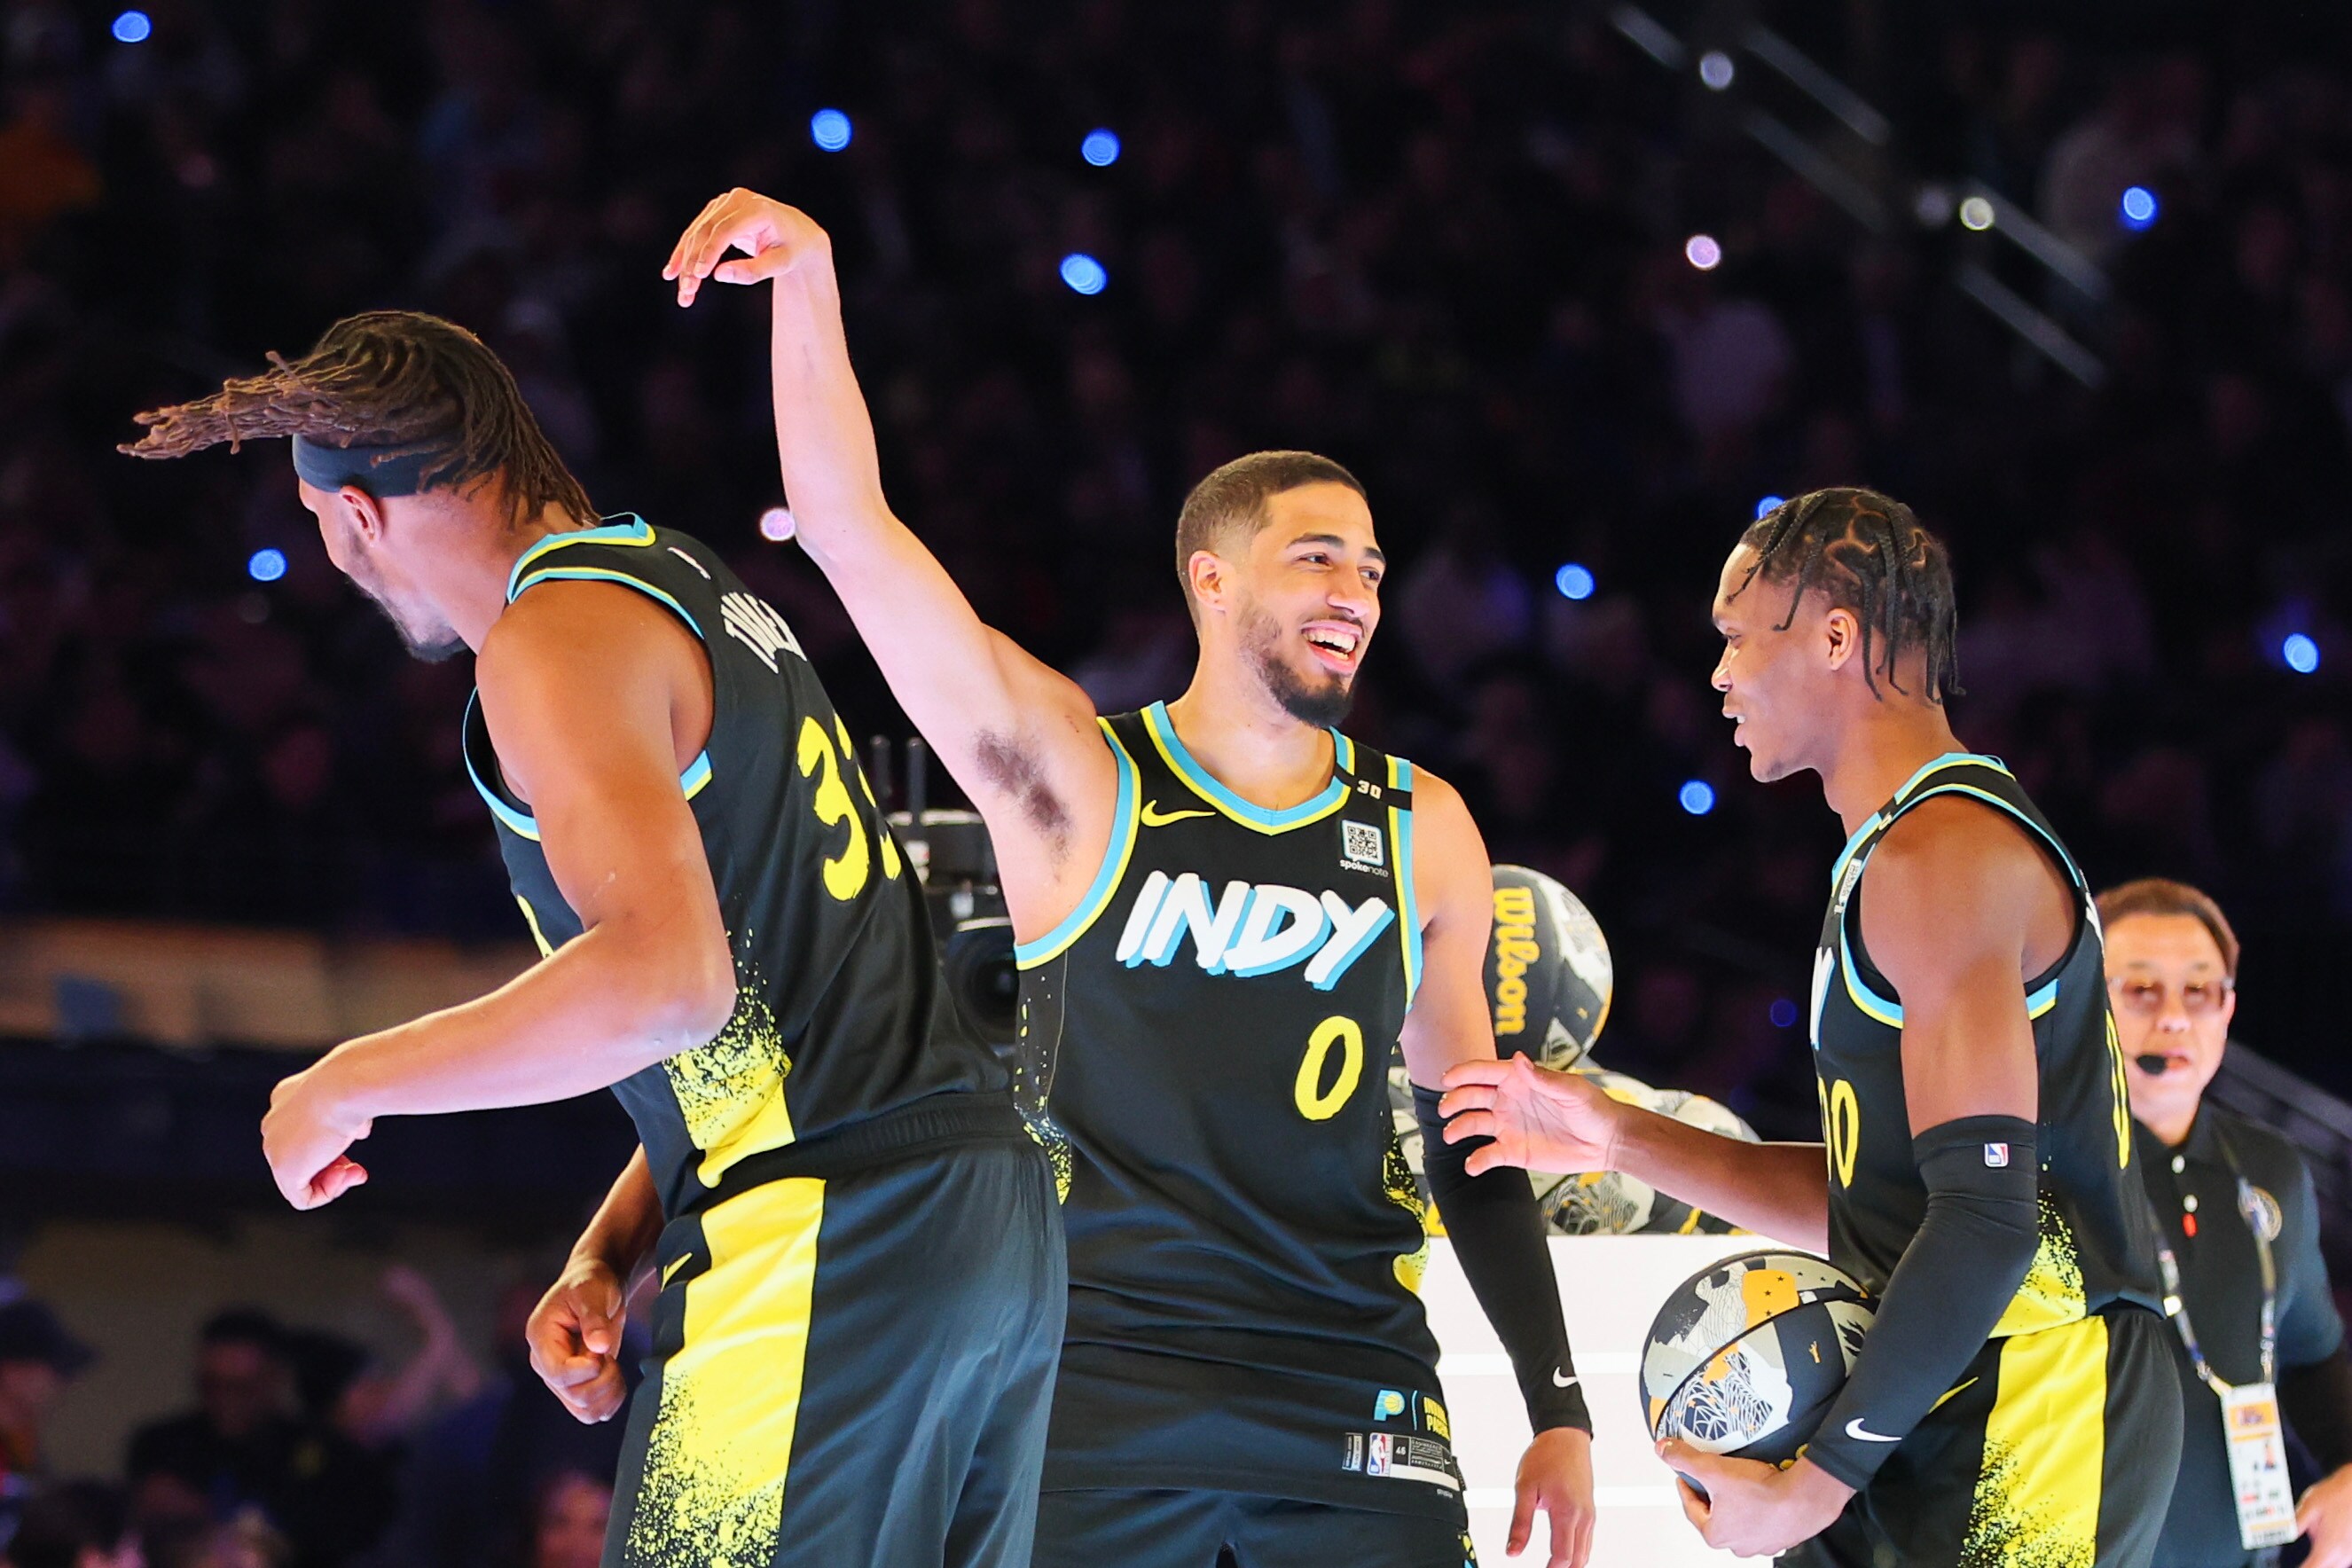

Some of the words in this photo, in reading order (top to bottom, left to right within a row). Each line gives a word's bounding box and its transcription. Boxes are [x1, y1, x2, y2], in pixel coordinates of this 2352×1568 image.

[1356, 780, 1382, 800] 30
[1339, 858, 1389, 878] spokenote
[1115, 870, 1396, 991] INDY
[1294, 1015, 1364, 1122] 0
